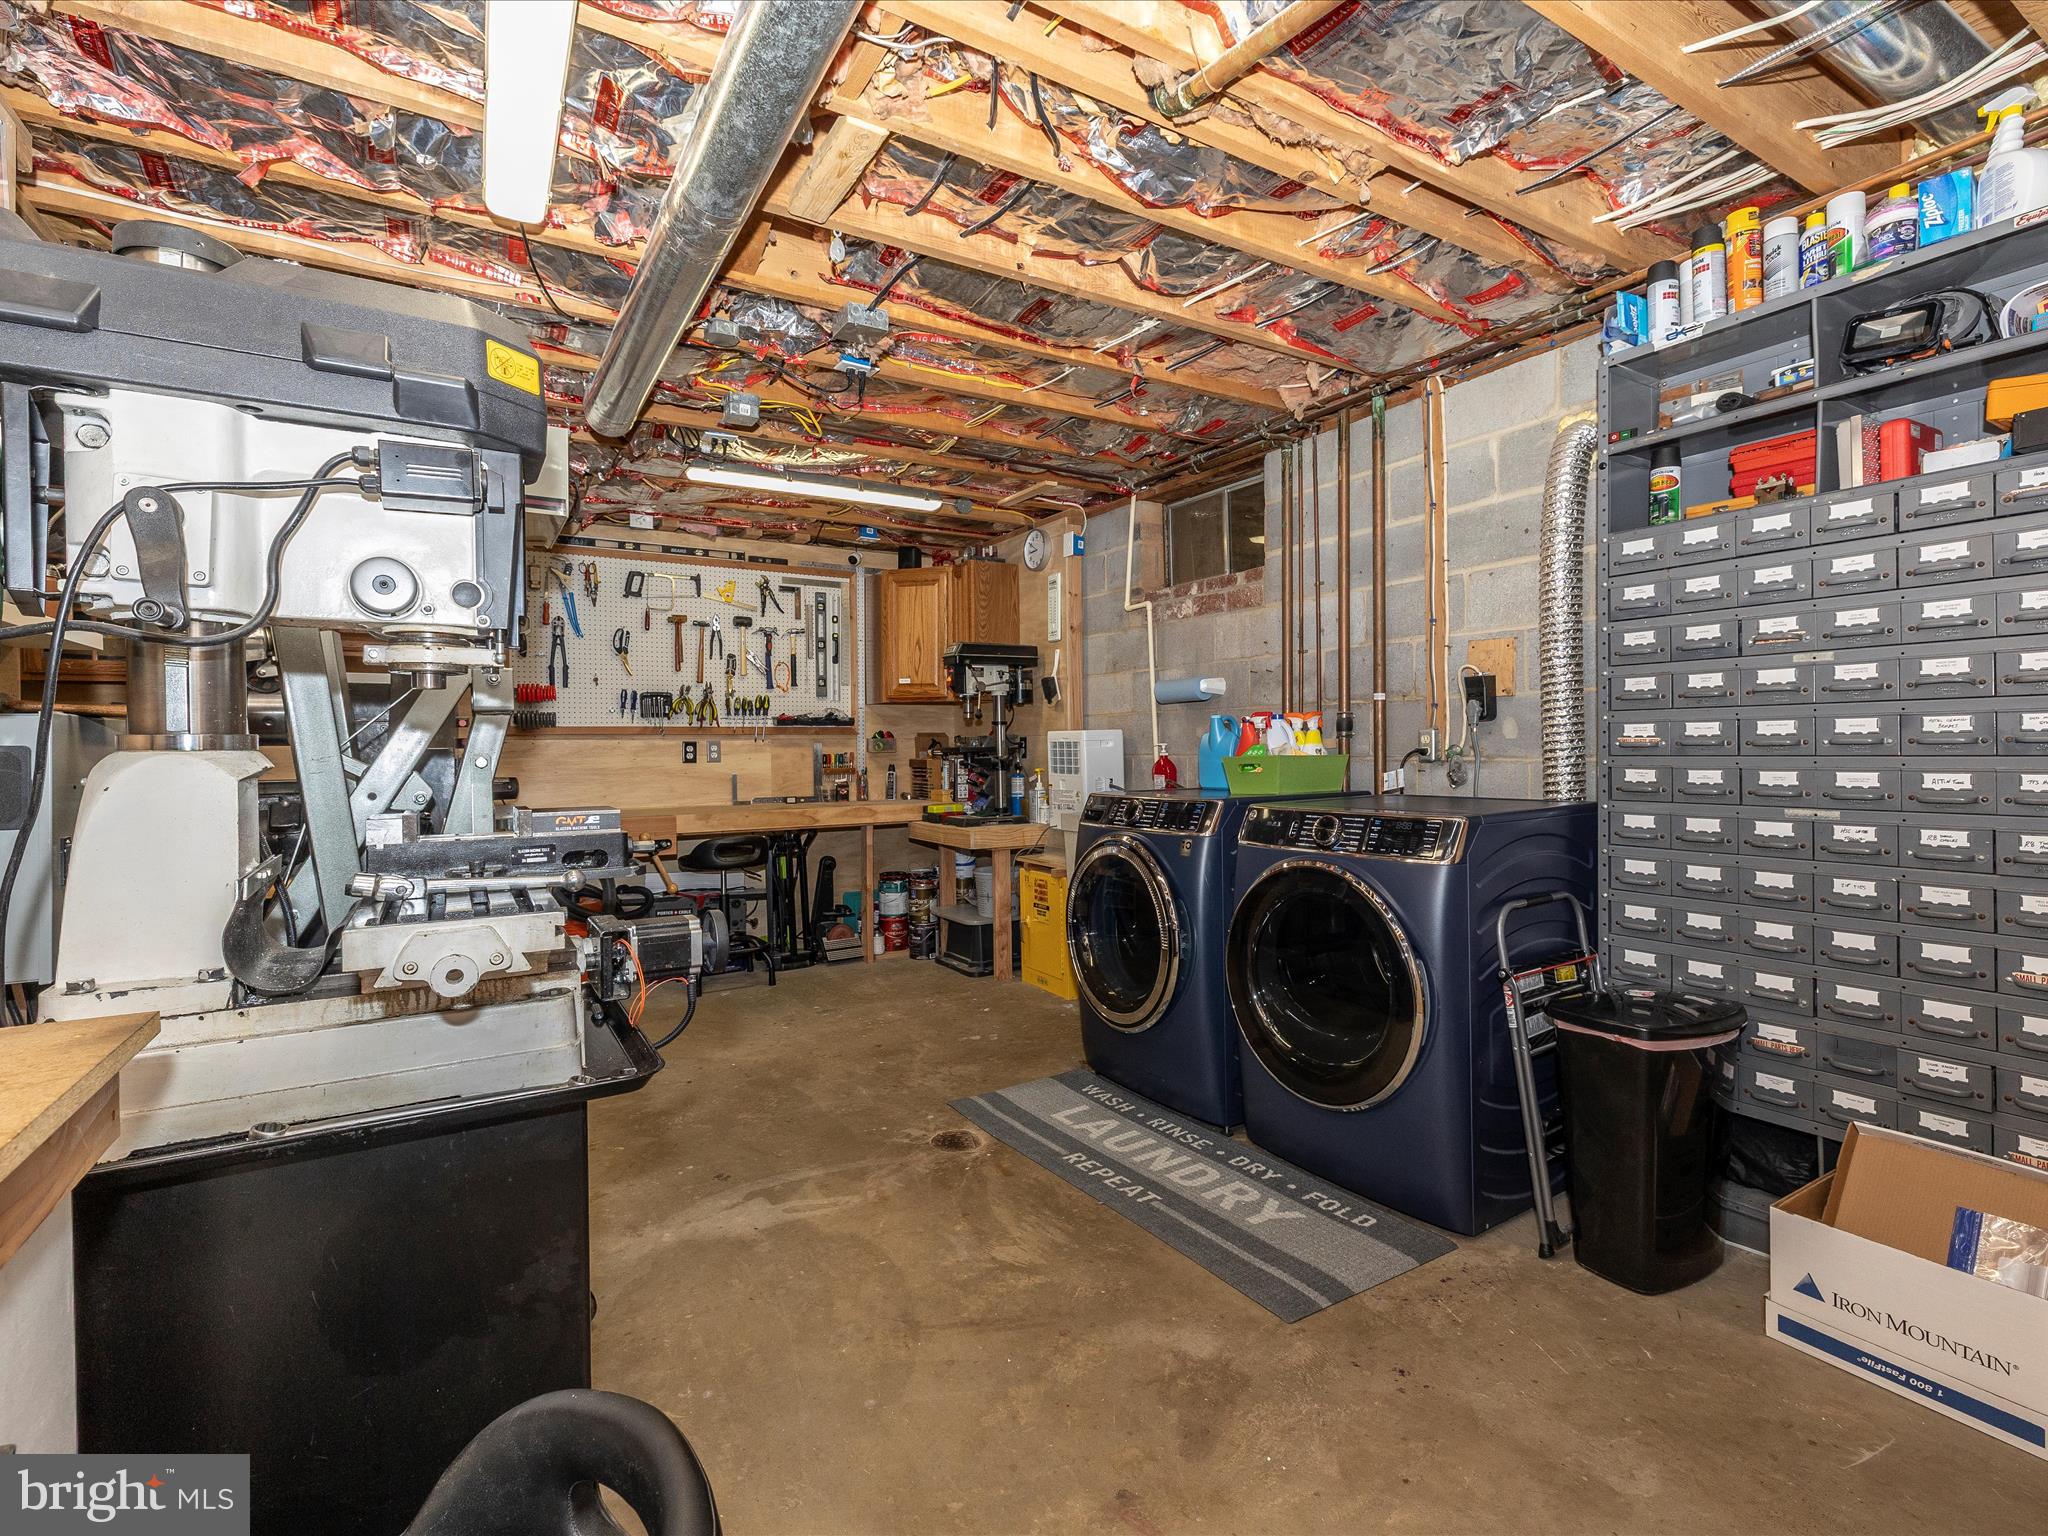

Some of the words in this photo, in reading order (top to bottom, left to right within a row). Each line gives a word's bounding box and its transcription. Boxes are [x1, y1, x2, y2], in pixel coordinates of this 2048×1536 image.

[1920, 191, 1945, 230] Ziploc
[1629, 303, 1640, 334] Ziploc
[1050, 1103, 1307, 1227] LAUNDRY
[1081, 1084, 1137, 1118] WASH
[1146, 1115, 1216, 1152] RINSE
[1227, 1154, 1284, 1183] DRY
[1301, 1191, 1379, 1230] FOLD
[1062, 1151, 1162, 1207] REPEAT
[1831, 1291, 1882, 1326] IRON
[1909, 1378, 1934, 1394] 800
